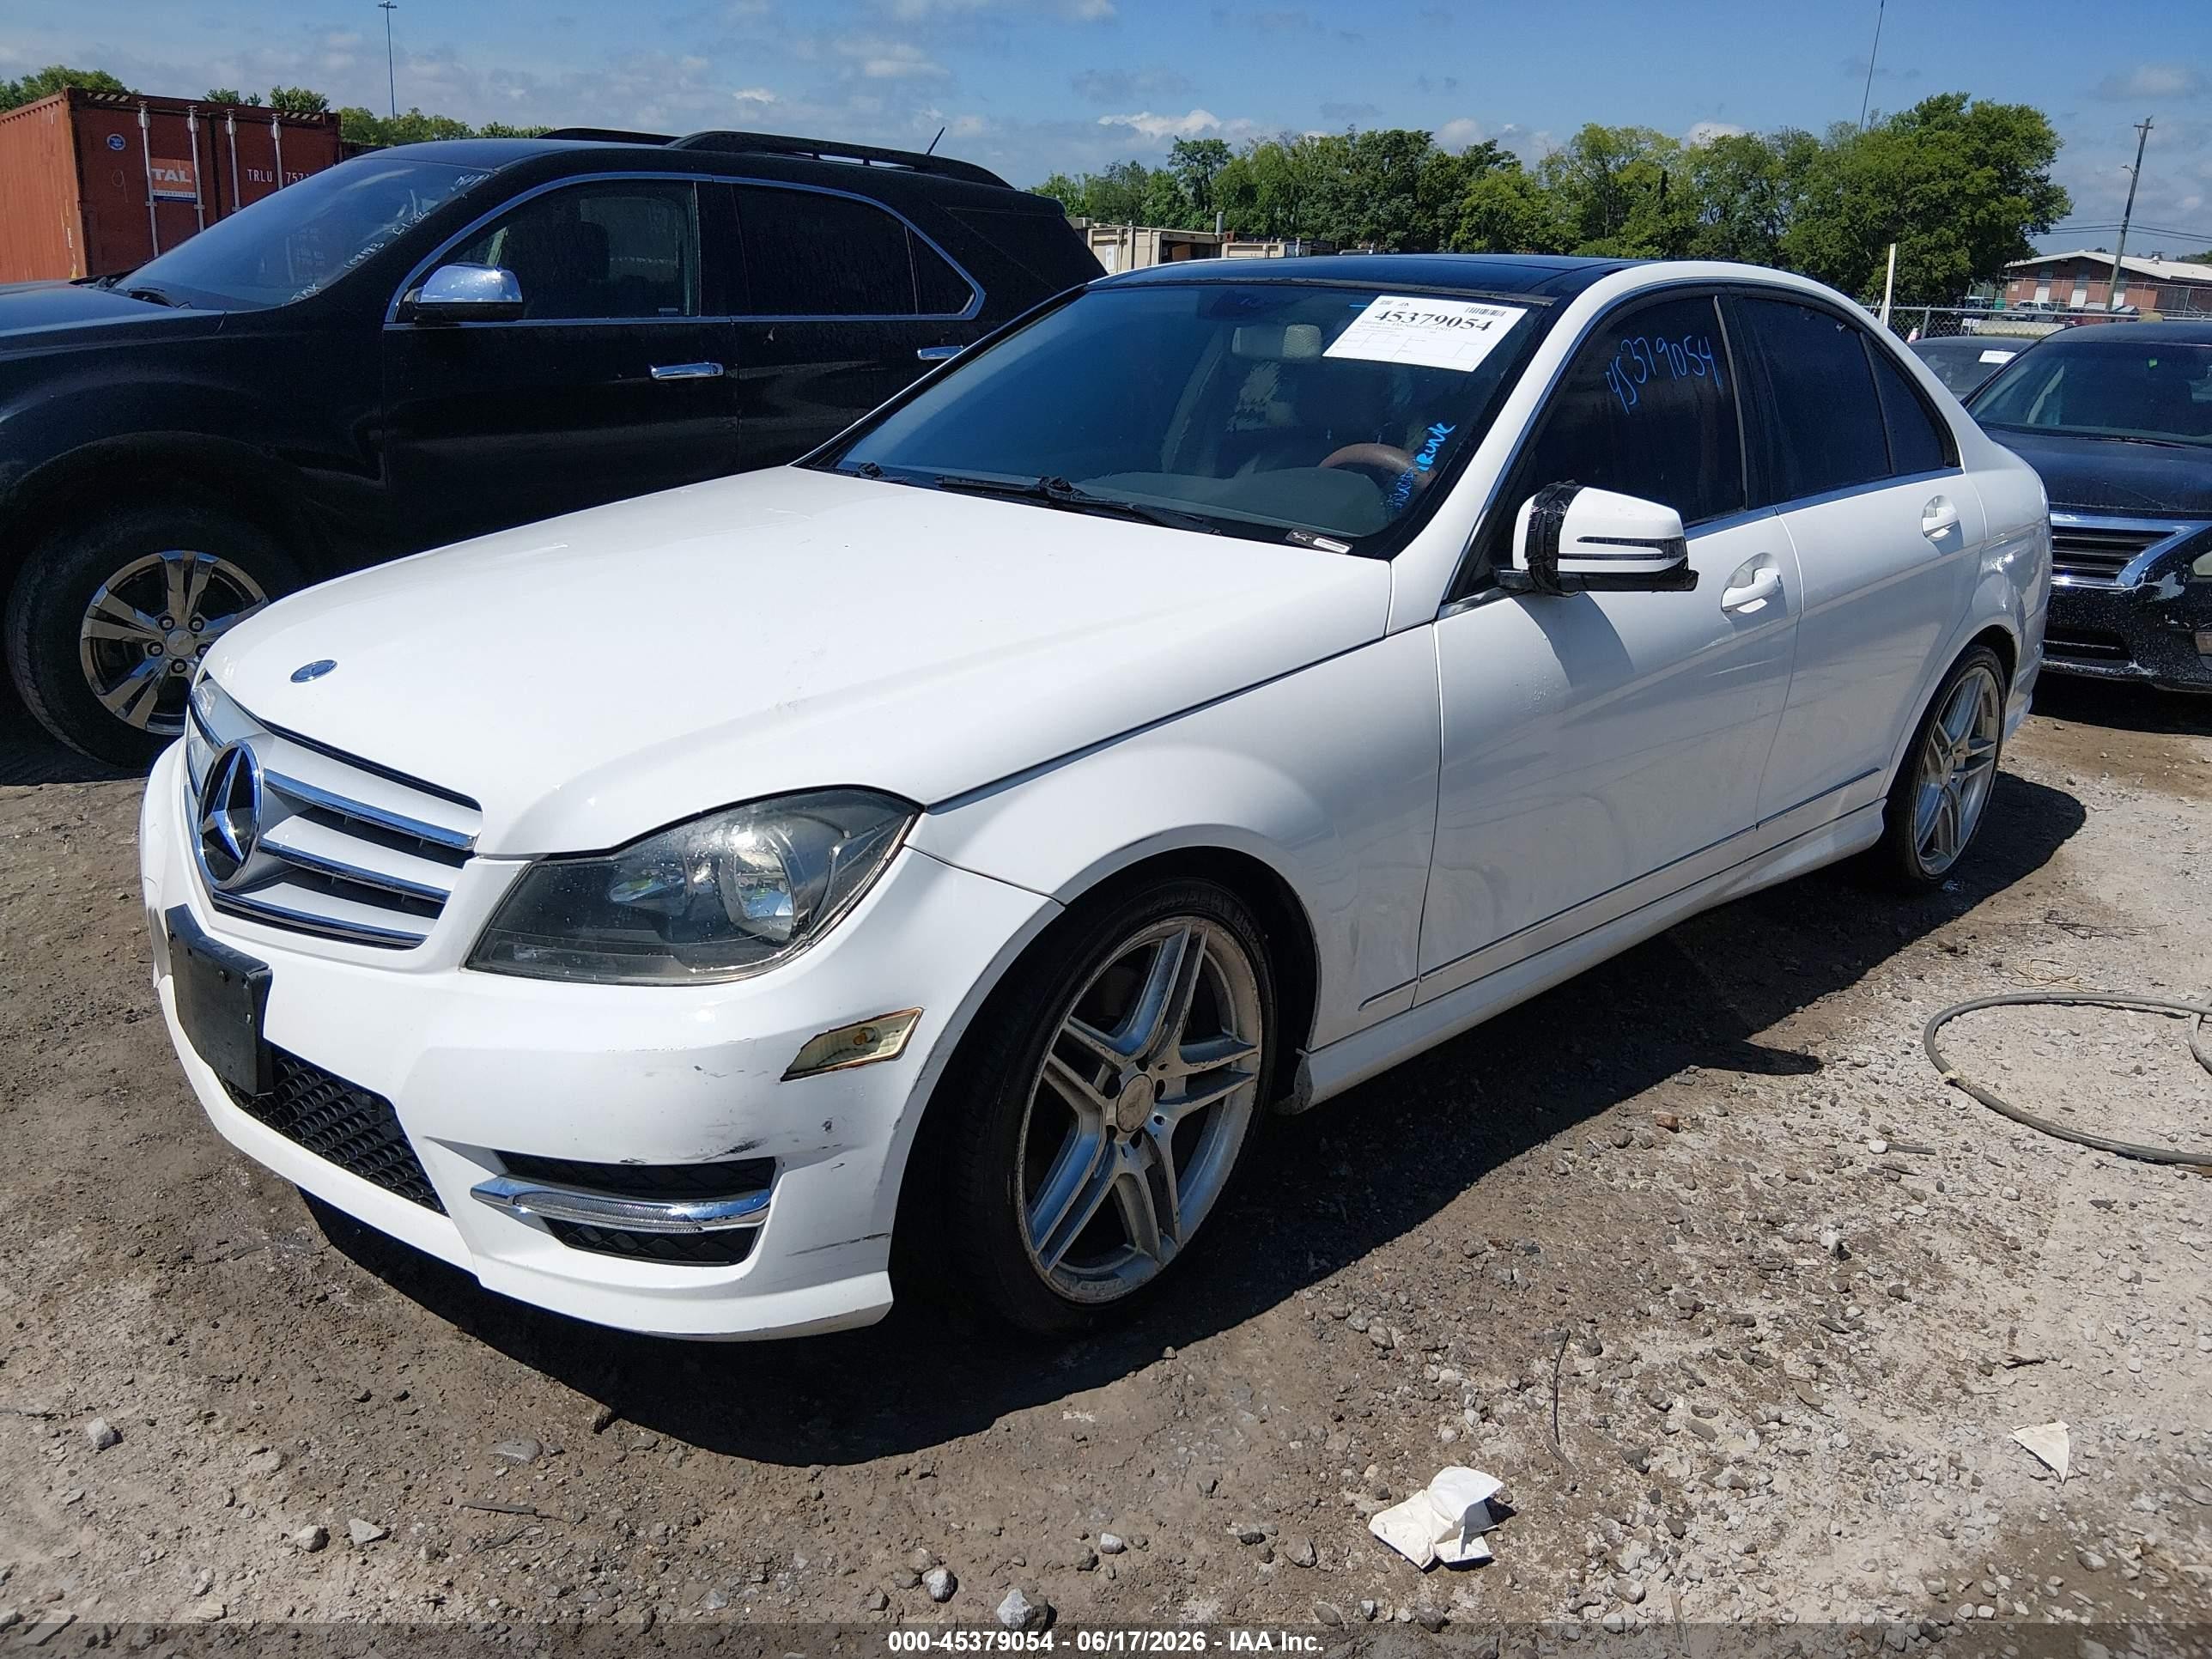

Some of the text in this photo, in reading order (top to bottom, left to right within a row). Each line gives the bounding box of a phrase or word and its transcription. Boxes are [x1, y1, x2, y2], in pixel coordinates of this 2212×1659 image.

[151, 168, 191, 183] TAL
[247, 168, 273, 183] TRLU
[1375, 310, 1494, 331] 45379054
[1604, 335, 1723, 416] 45379054
